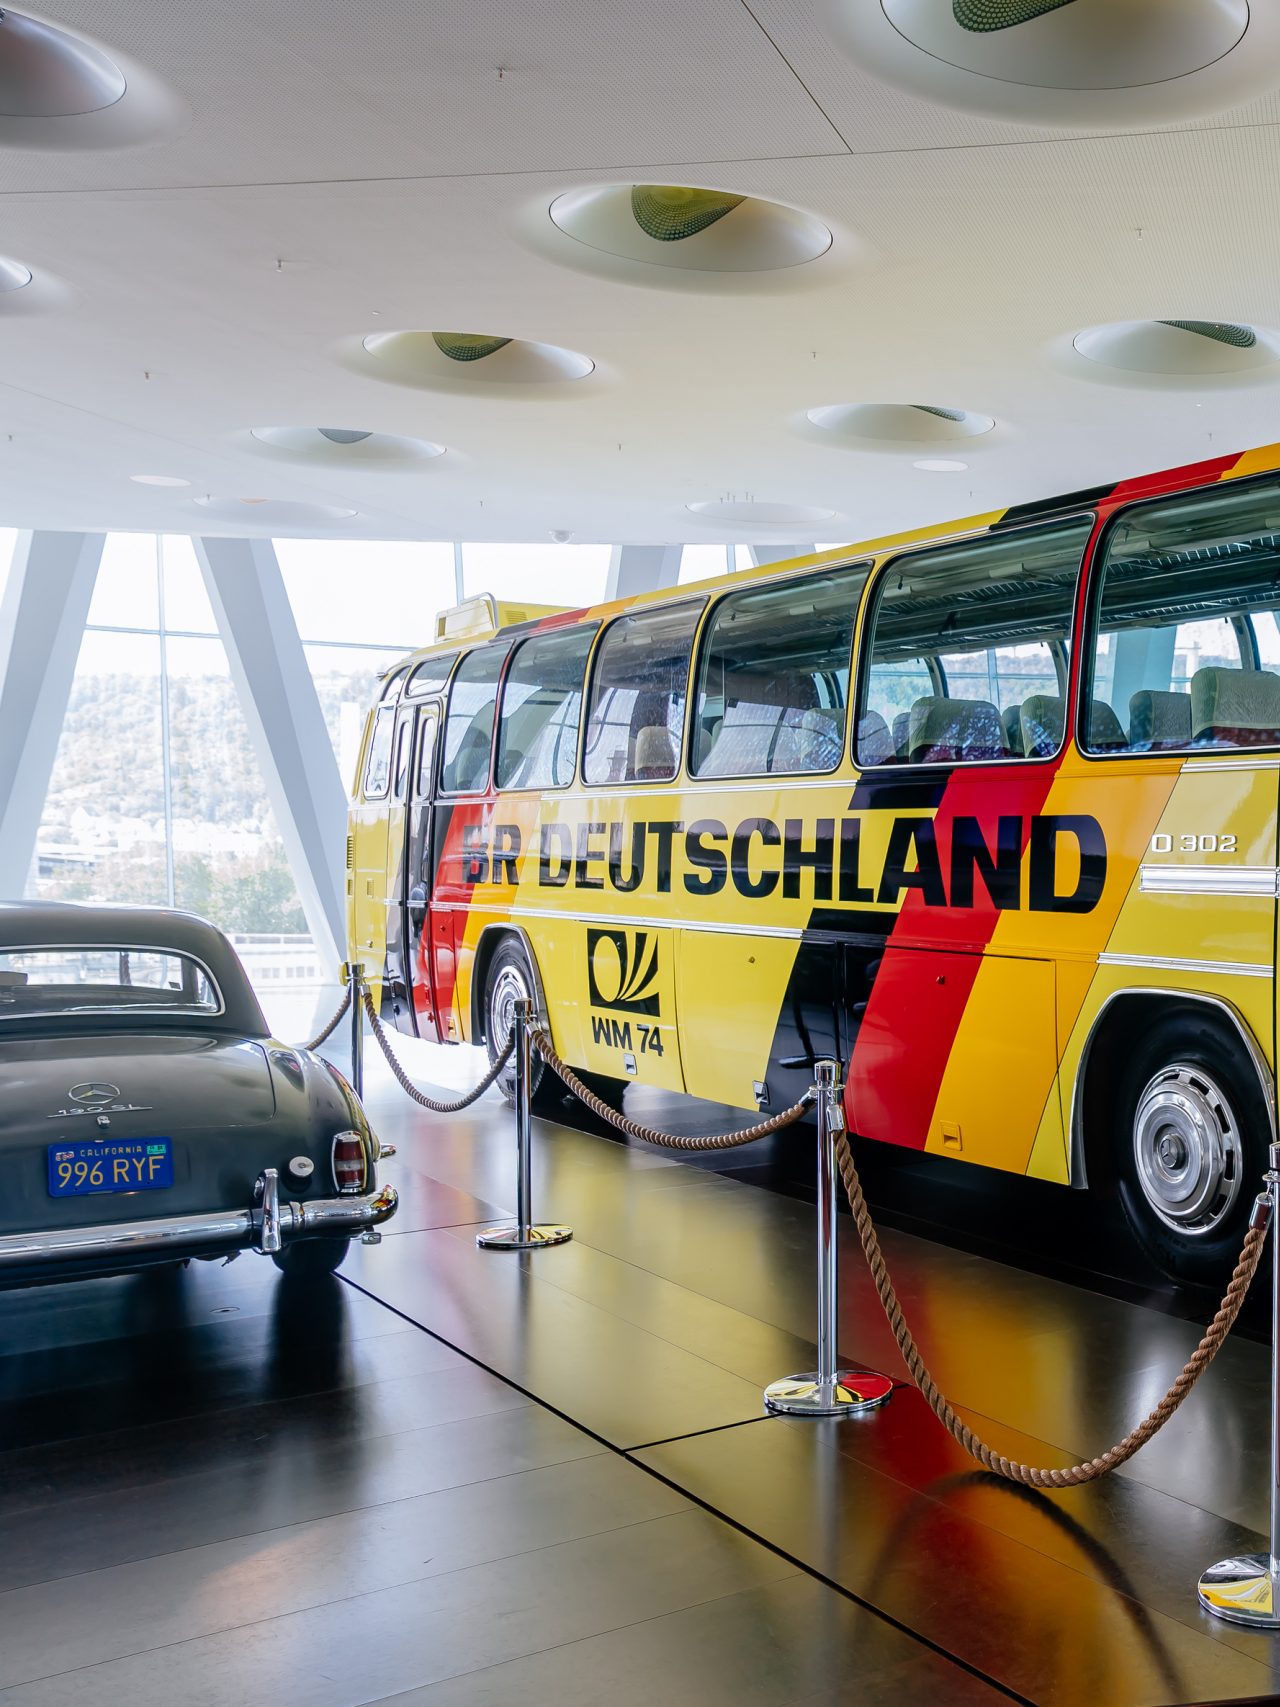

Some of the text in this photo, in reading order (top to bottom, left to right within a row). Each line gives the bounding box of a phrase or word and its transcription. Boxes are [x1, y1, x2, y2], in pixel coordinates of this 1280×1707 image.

[1179, 834, 1238, 853] 302
[461, 813, 1108, 914] BR DEUTSCHLAND
[591, 1015, 664, 1057] WM 74
[80, 1145, 143, 1158] CALIFORNIA
[57, 1155, 165, 1188] 996 RYF
